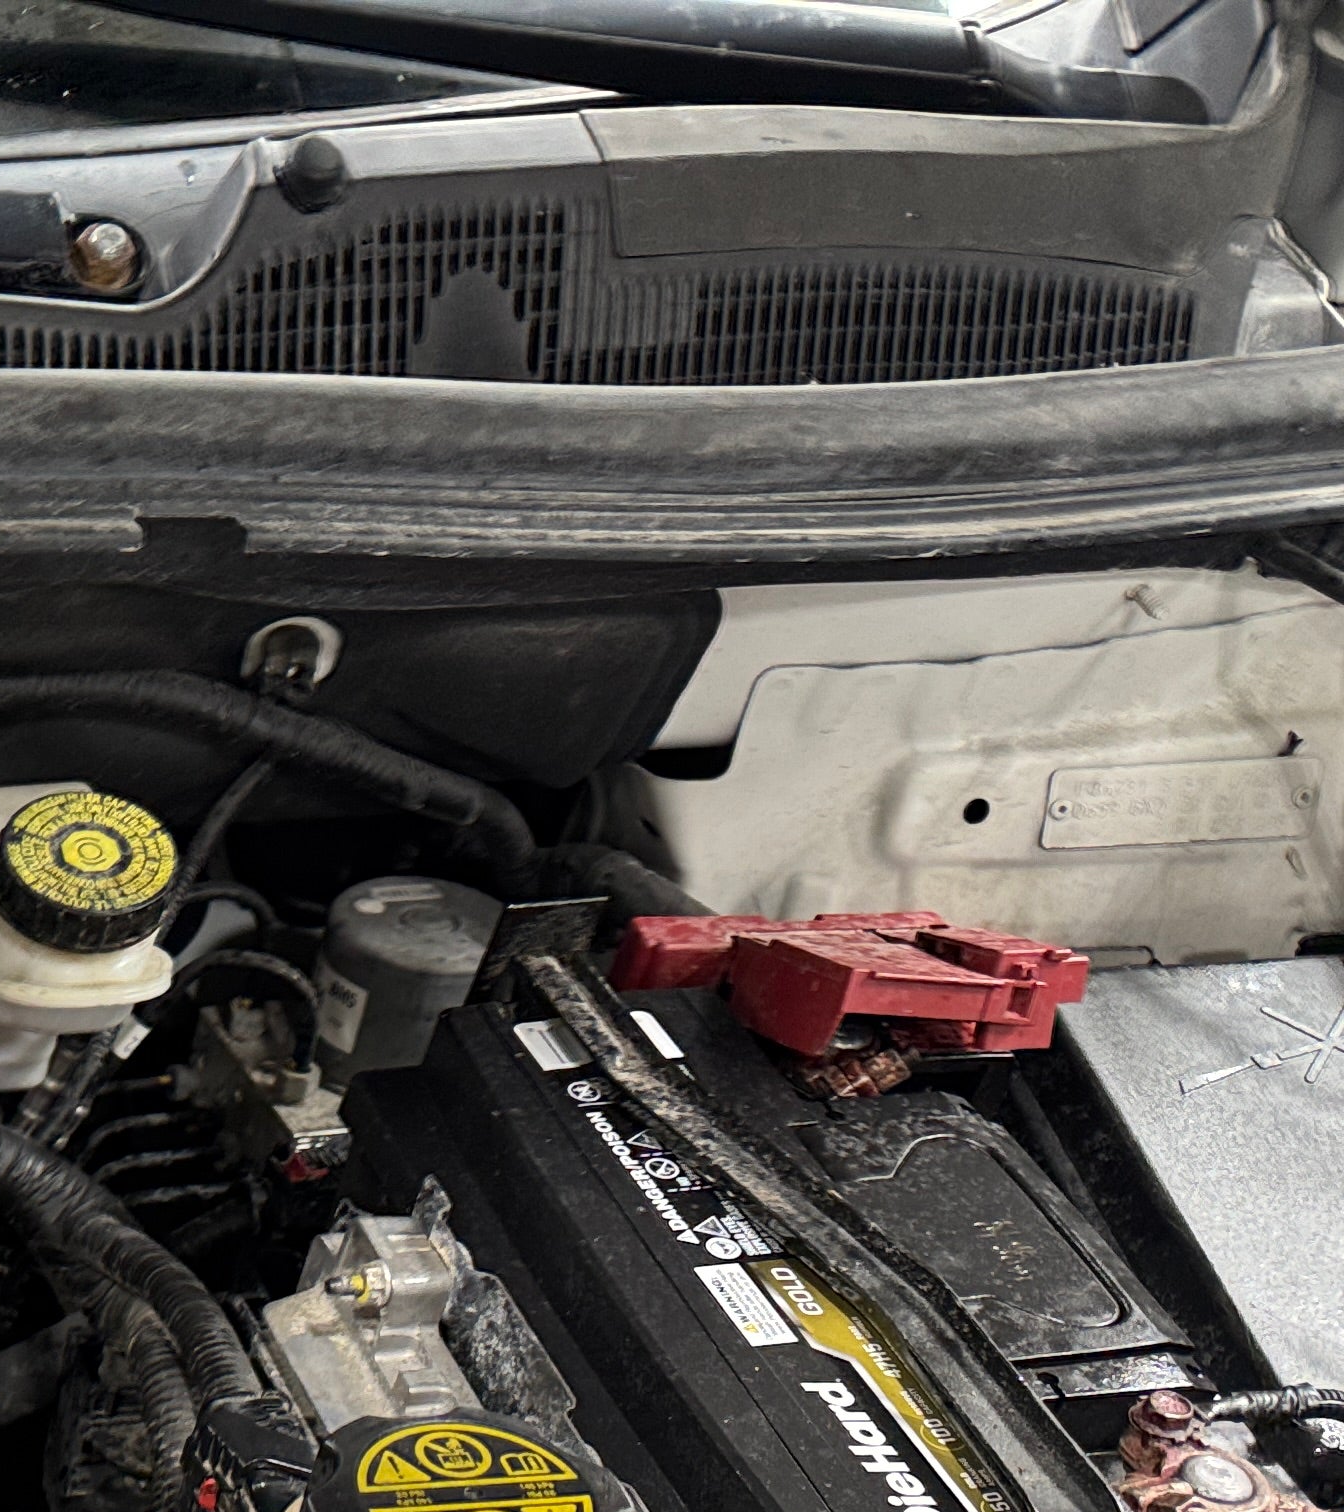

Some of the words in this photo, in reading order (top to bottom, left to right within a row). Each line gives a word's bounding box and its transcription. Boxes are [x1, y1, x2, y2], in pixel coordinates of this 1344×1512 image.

[586, 1111, 689, 1232] DANGER/POISON
[770, 1267, 824, 1316] GOLD
[923, 1417, 956, 1445] 100
